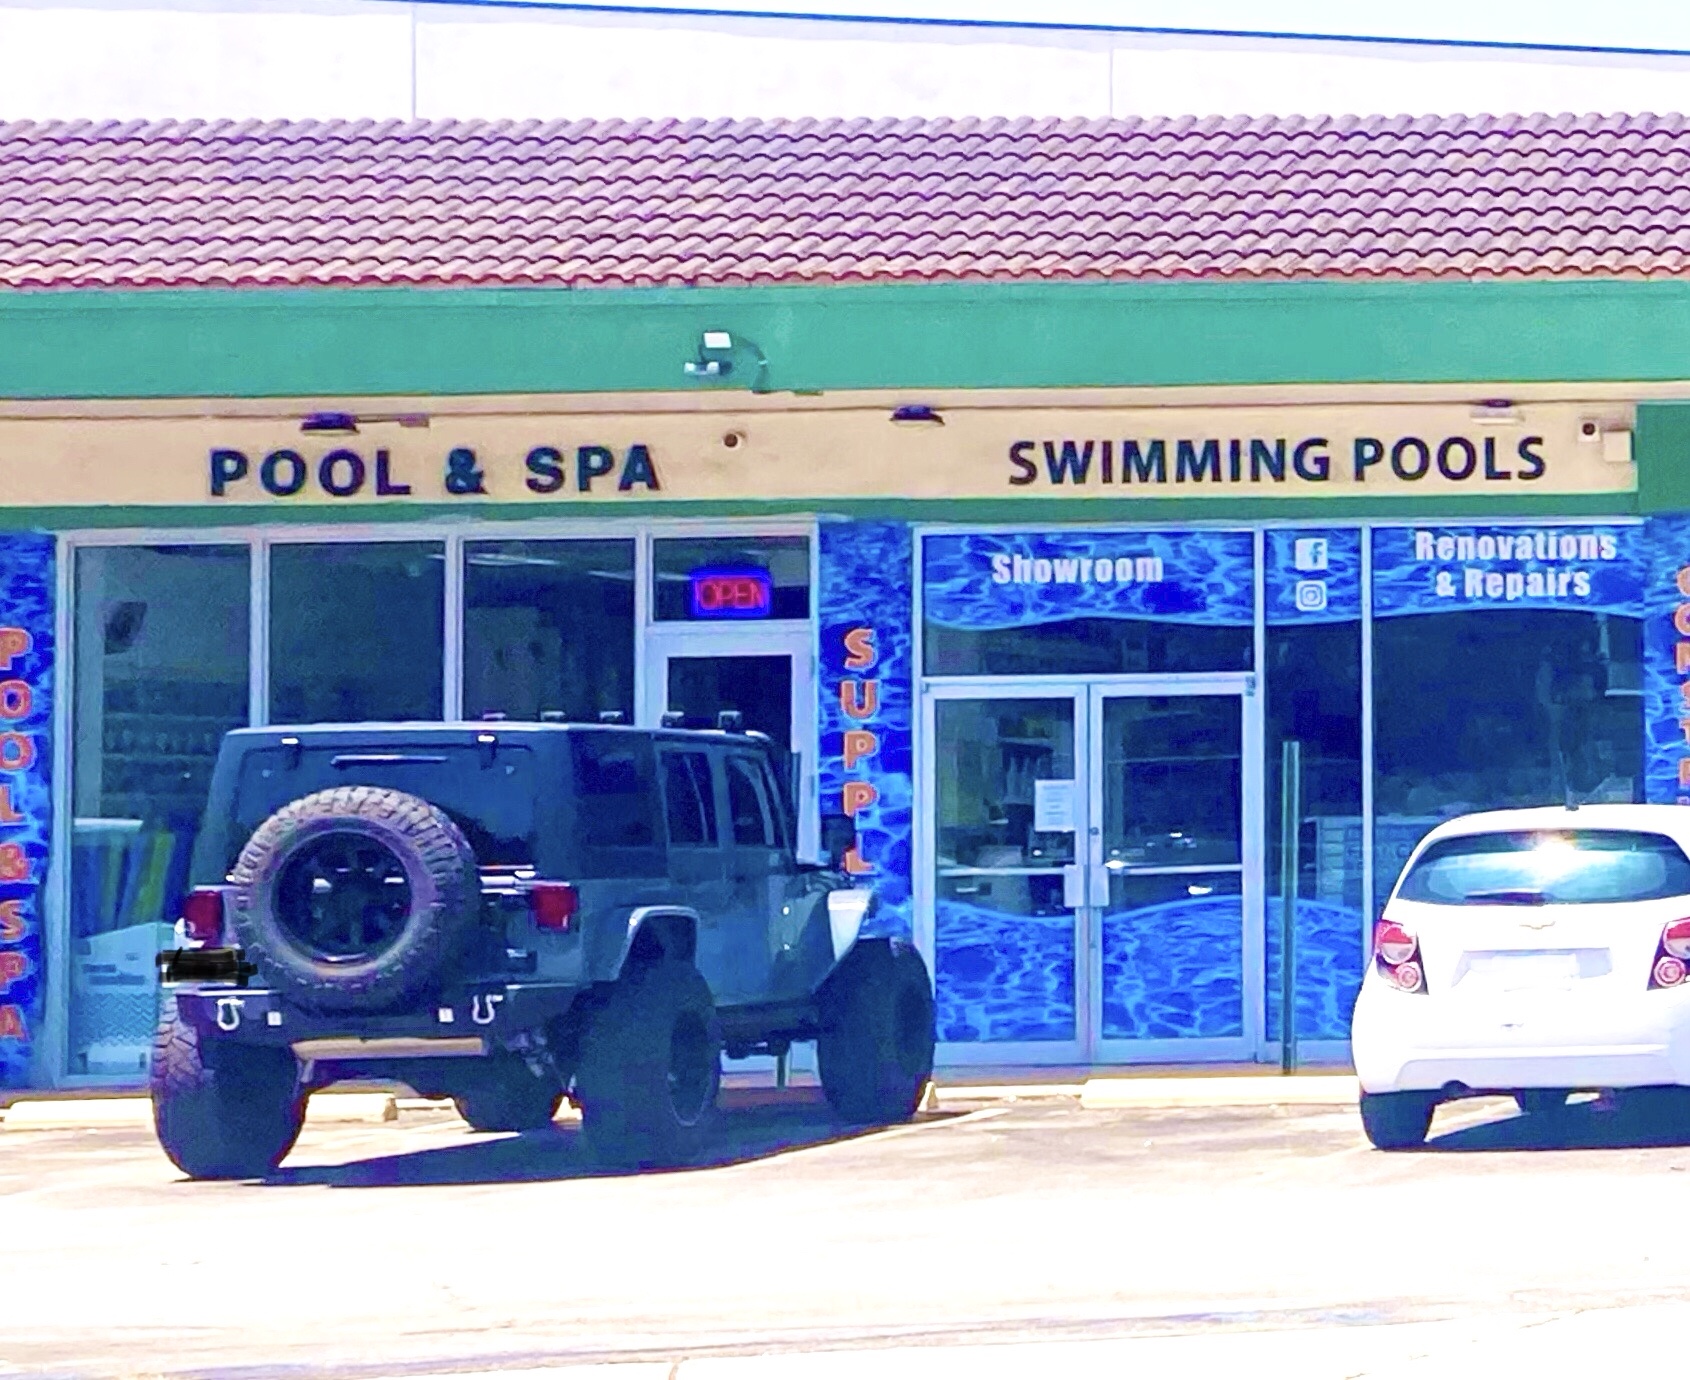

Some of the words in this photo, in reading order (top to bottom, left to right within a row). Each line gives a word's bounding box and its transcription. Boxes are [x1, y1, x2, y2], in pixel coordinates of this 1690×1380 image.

[209, 448, 412, 498] POOL
[443, 446, 489, 496] &
[524, 444, 662, 494] SPA
[1007, 437, 1332, 486] SWIMMING
[1353, 435, 1547, 482] POOLS
[1415, 530, 1617, 561] Renovations
[991, 553, 1163, 584] Showroom
[699, 577, 763, 610] OPEN
[1436, 571, 1456, 598] &
[1464, 569, 1591, 601] Repairs
